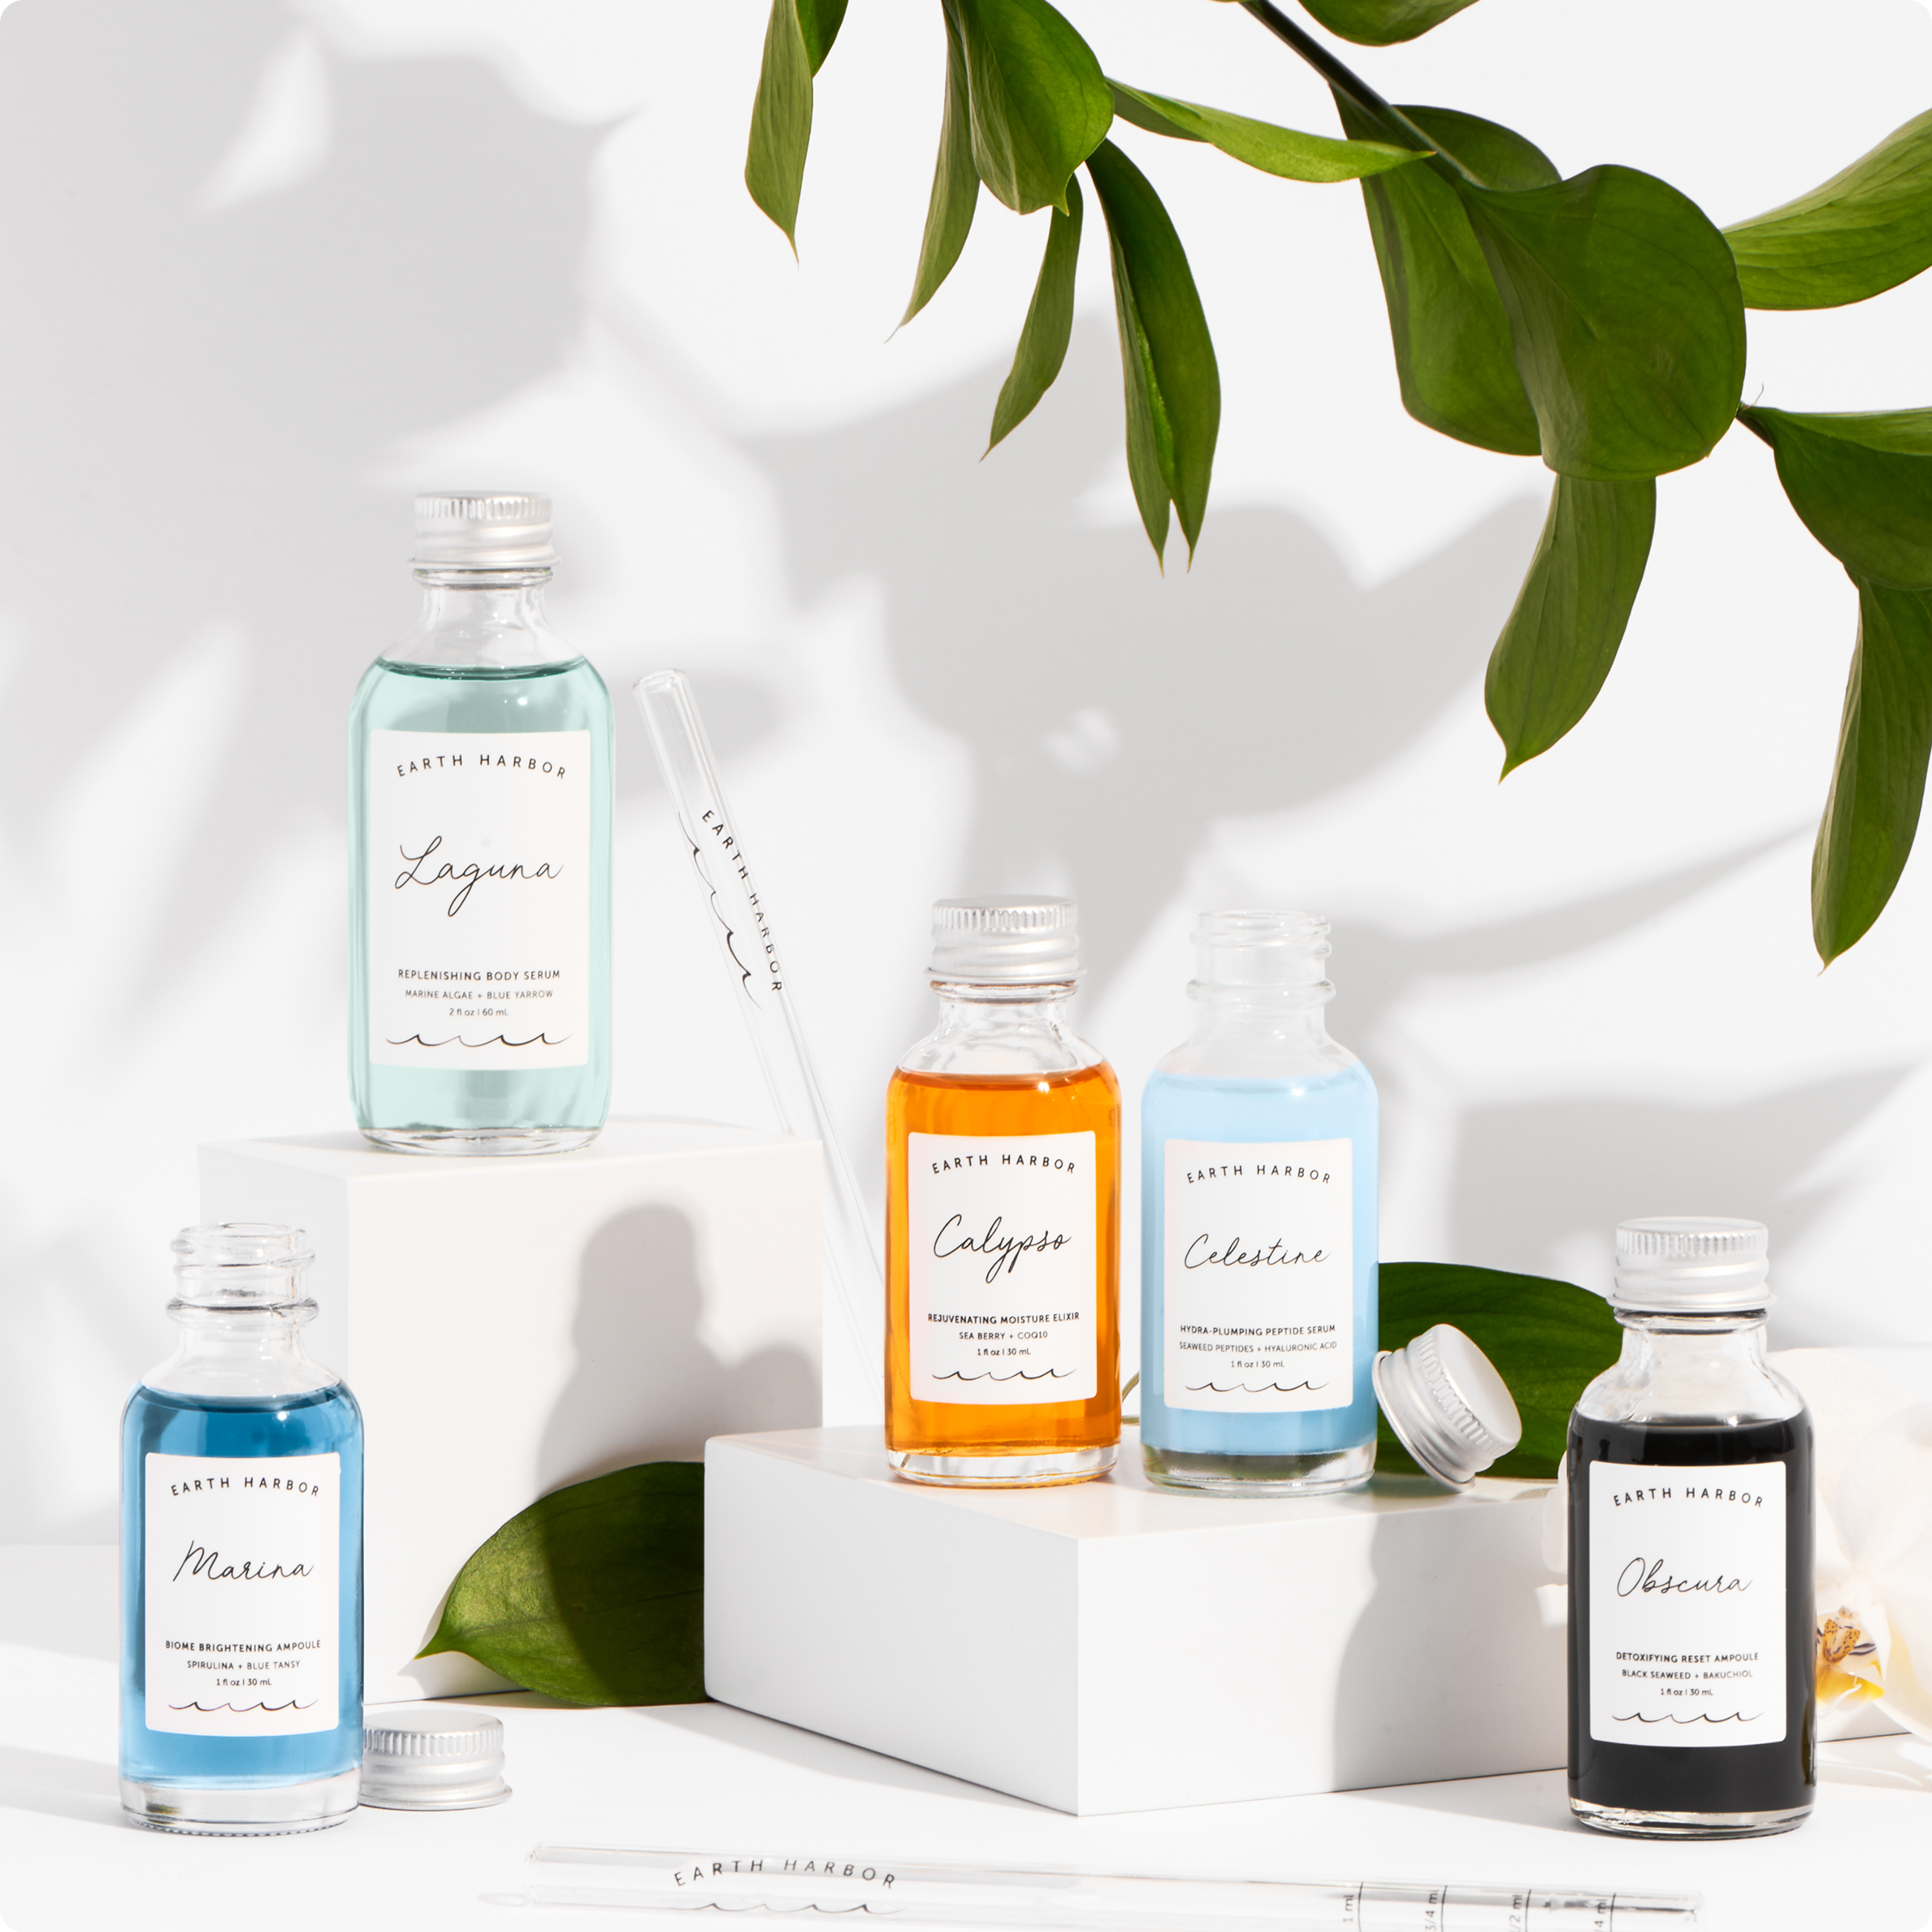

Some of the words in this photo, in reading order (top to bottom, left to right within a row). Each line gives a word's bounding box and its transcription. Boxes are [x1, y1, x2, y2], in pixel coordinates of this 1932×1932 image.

[397, 754, 463, 777] EARTH
[479, 753, 565, 779] HARBOR
[394, 835, 565, 918] Laguna
[701, 809, 749, 880] EARTH
[750, 892, 782, 991] HARBOR
[398, 968, 482, 981] REPLENISHING
[486, 971, 519, 981] BODY
[523, 969, 560, 981] SERUM
[405, 989, 439, 999] MARINE
[442, 991, 473, 1000] ALGAE
[487, 991, 510, 999] BLUE
[514, 990, 554, 999] YARROW
[456, 1008, 462, 1016] fl
[482, 1008, 494, 1017] 60
[495, 1008, 509, 1017] mL
[932, 1154, 988, 1175] EARTH
[1002, 1154, 1075, 1174] HARBOR
[1187, 1164, 1243, 1184] EARTH
[1257, 1164, 1330, 1184] HARBOR
[933, 1213, 1072, 1284] Calypso
[1184, 1233, 1332, 1269] Celestine
[927, 1313, 997, 1325] REJUVENATING
[999, 1314, 1050, 1324] MOISTURE
[1053, 1312, 1080, 1322] ELIXIR
[959, 1332, 975, 1340] SEA
[977, 1332, 1006, 1341] BERRY
[1017, 1330, 1048, 1340] COQ10
[1180, 1325, 1263, 1336] HYDRA-PLUMPING
[1265, 1326, 1304, 1336] PEPTIDE
[1307, 1324, 1335, 1335] SERUM
[983, 1348, 989, 1356] fl
[1007, 1347, 1017, 1356] 30
[1018, 1347, 1031, 1355] mL
[1179, 1341, 1213, 1352] SEAWEED
[1215, 1343, 1254, 1353] PEPTIDES
[1264, 1342, 1317, 1352] HYALURONIC
[1319, 1341, 1338, 1350] ACID
[1236, 1360, 1242, 1368] fl
[1261, 1360, 1271, 1369] 30
[1272, 1360, 1285, 1368] mL
[170, 1476, 230, 1497] EARTH
[244, 1476, 319, 1497] HARBOR
[1612, 1487, 1672, 1507] EARTH
[1685, 1487, 1763, 1508] HARBOR
[172, 1540, 314, 1582] Marina
[1616, 1557, 1753, 1598] Obscura
[165, 1640, 195, 1651] BIOME
[198, 1642, 273, 1653] BRIGHTENING
[276, 1639, 321, 1652] AMPOULE
[1615, 1651, 1678, 1664] DETOXIFYING
[1681, 1654, 1711, 1664] RESET
[1714, 1652, 1759, 1662] AMPOULE
[187, 1660, 234, 1670] SPIRULINA
[247, 1662, 270, 1670] BLUE
[273, 1660, 300, 1669] TANSY
[1621, 1668, 1648, 1678] BLACK
[1650, 1670, 1691, 1680] SEAWEED
[1702, 1670, 1752, 1679] BAKUCHIOL
[222, 1678, 229, 1686] fl
[247, 1678, 258, 1687] 30
[259, 1678, 272, 1686] mL
[1666, 1688, 1672, 1696] fl
[1690, 1688, 1700, 1696] 30
[1701, 1688, 1714, 1696] mL
[674, 1859, 763, 1887] EARTH
[784, 1859, 895, 1889] HARBOR
